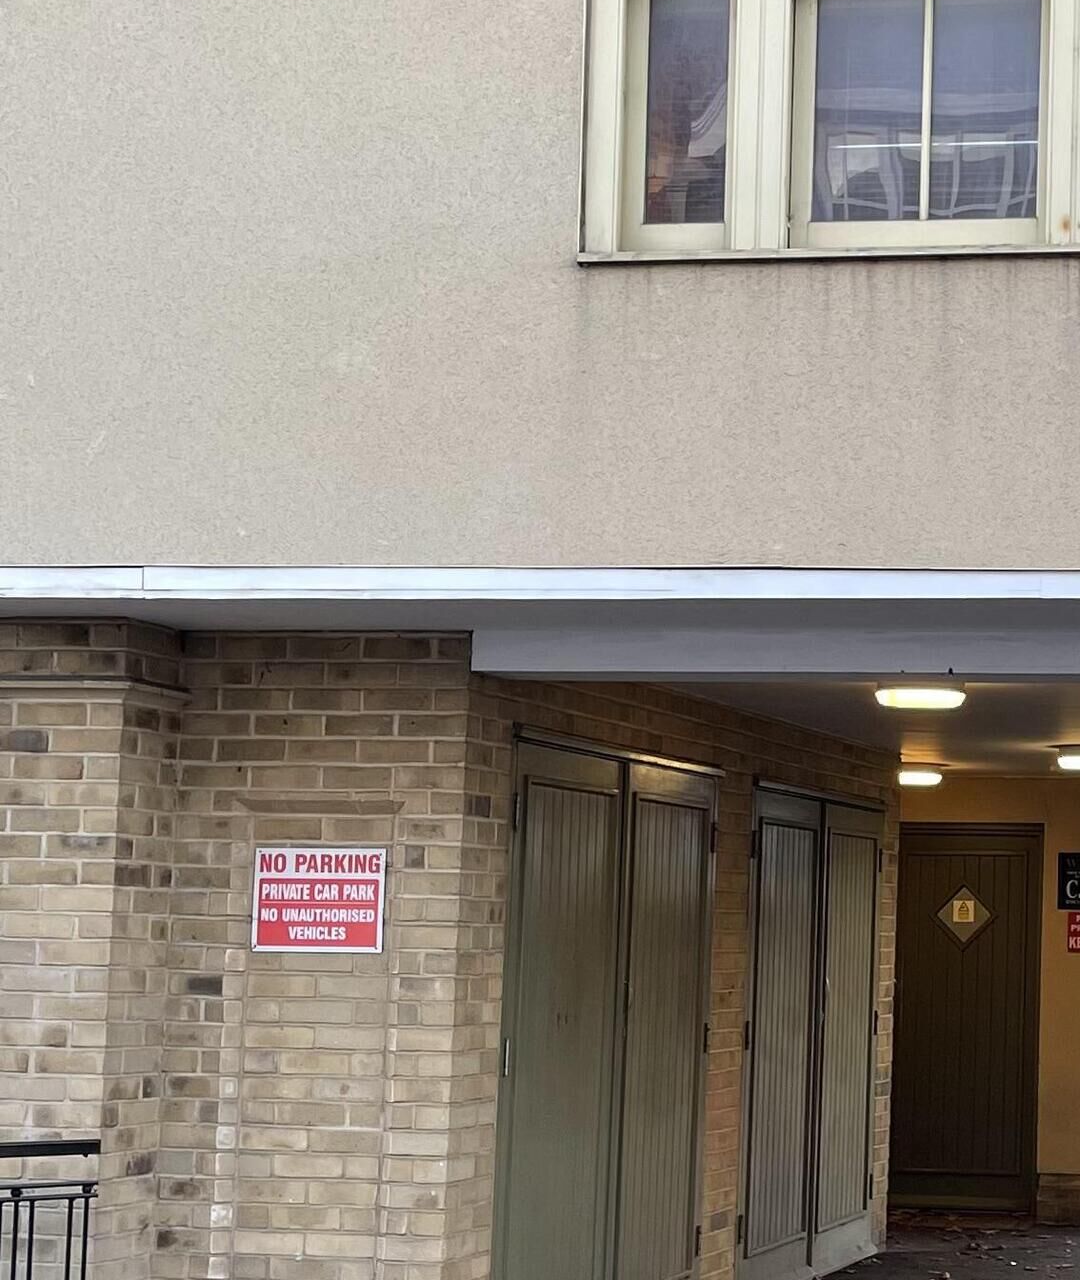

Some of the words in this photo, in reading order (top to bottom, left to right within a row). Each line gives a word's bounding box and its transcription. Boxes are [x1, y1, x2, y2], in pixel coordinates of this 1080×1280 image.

[260, 853, 287, 873] NO
[295, 854, 380, 873] PARKING
[262, 884, 310, 900] PRIVATE
[314, 884, 339, 900] CAR
[343, 885, 375, 900] PARK
[260, 908, 278, 922] NO
[282, 908, 375, 922] UNAUTHORISED
[288, 926, 346, 940] VEHICLES
